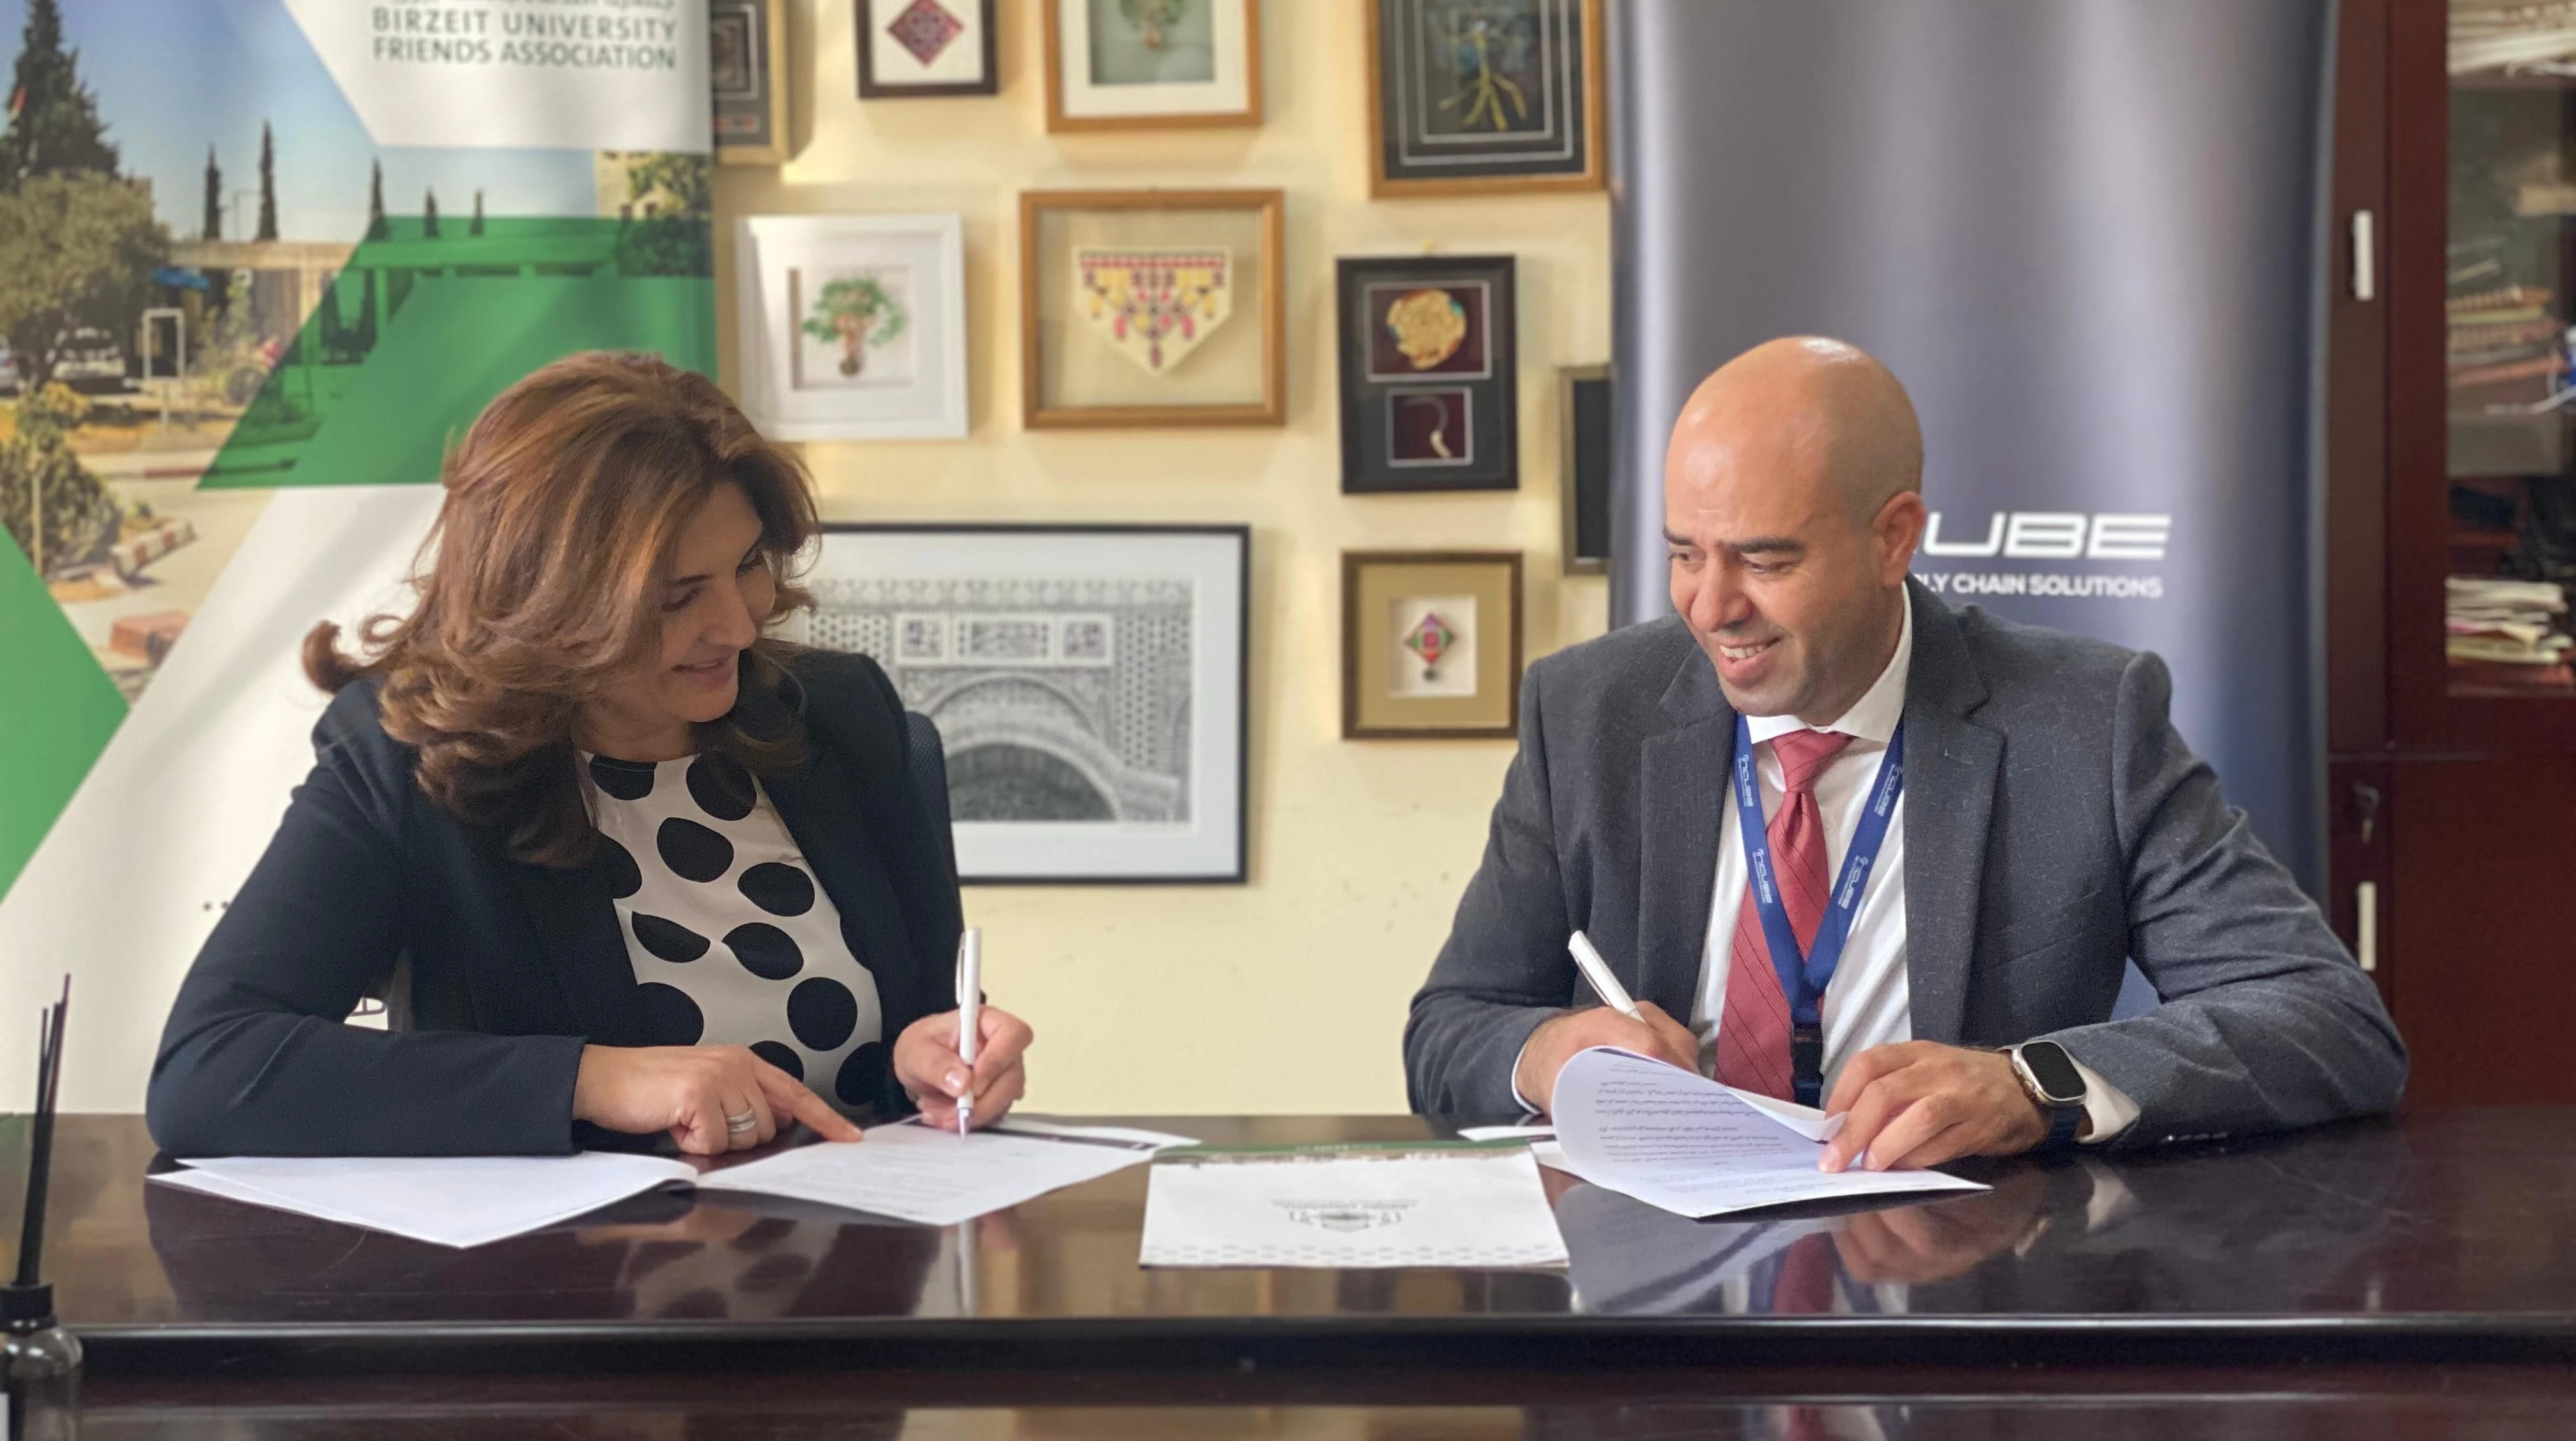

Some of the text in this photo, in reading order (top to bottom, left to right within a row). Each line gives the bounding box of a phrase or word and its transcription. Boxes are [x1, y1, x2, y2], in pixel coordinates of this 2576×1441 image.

[373, 7, 677, 42] BIRZEIT UNIVERSITY
[373, 37, 676, 70] FRIENDS ASSOCIATION
[1913, 512, 2170, 558] UBE
[1952, 574, 2026, 595] CHAIN
[2028, 574, 2163, 598] SOLUTIONS
